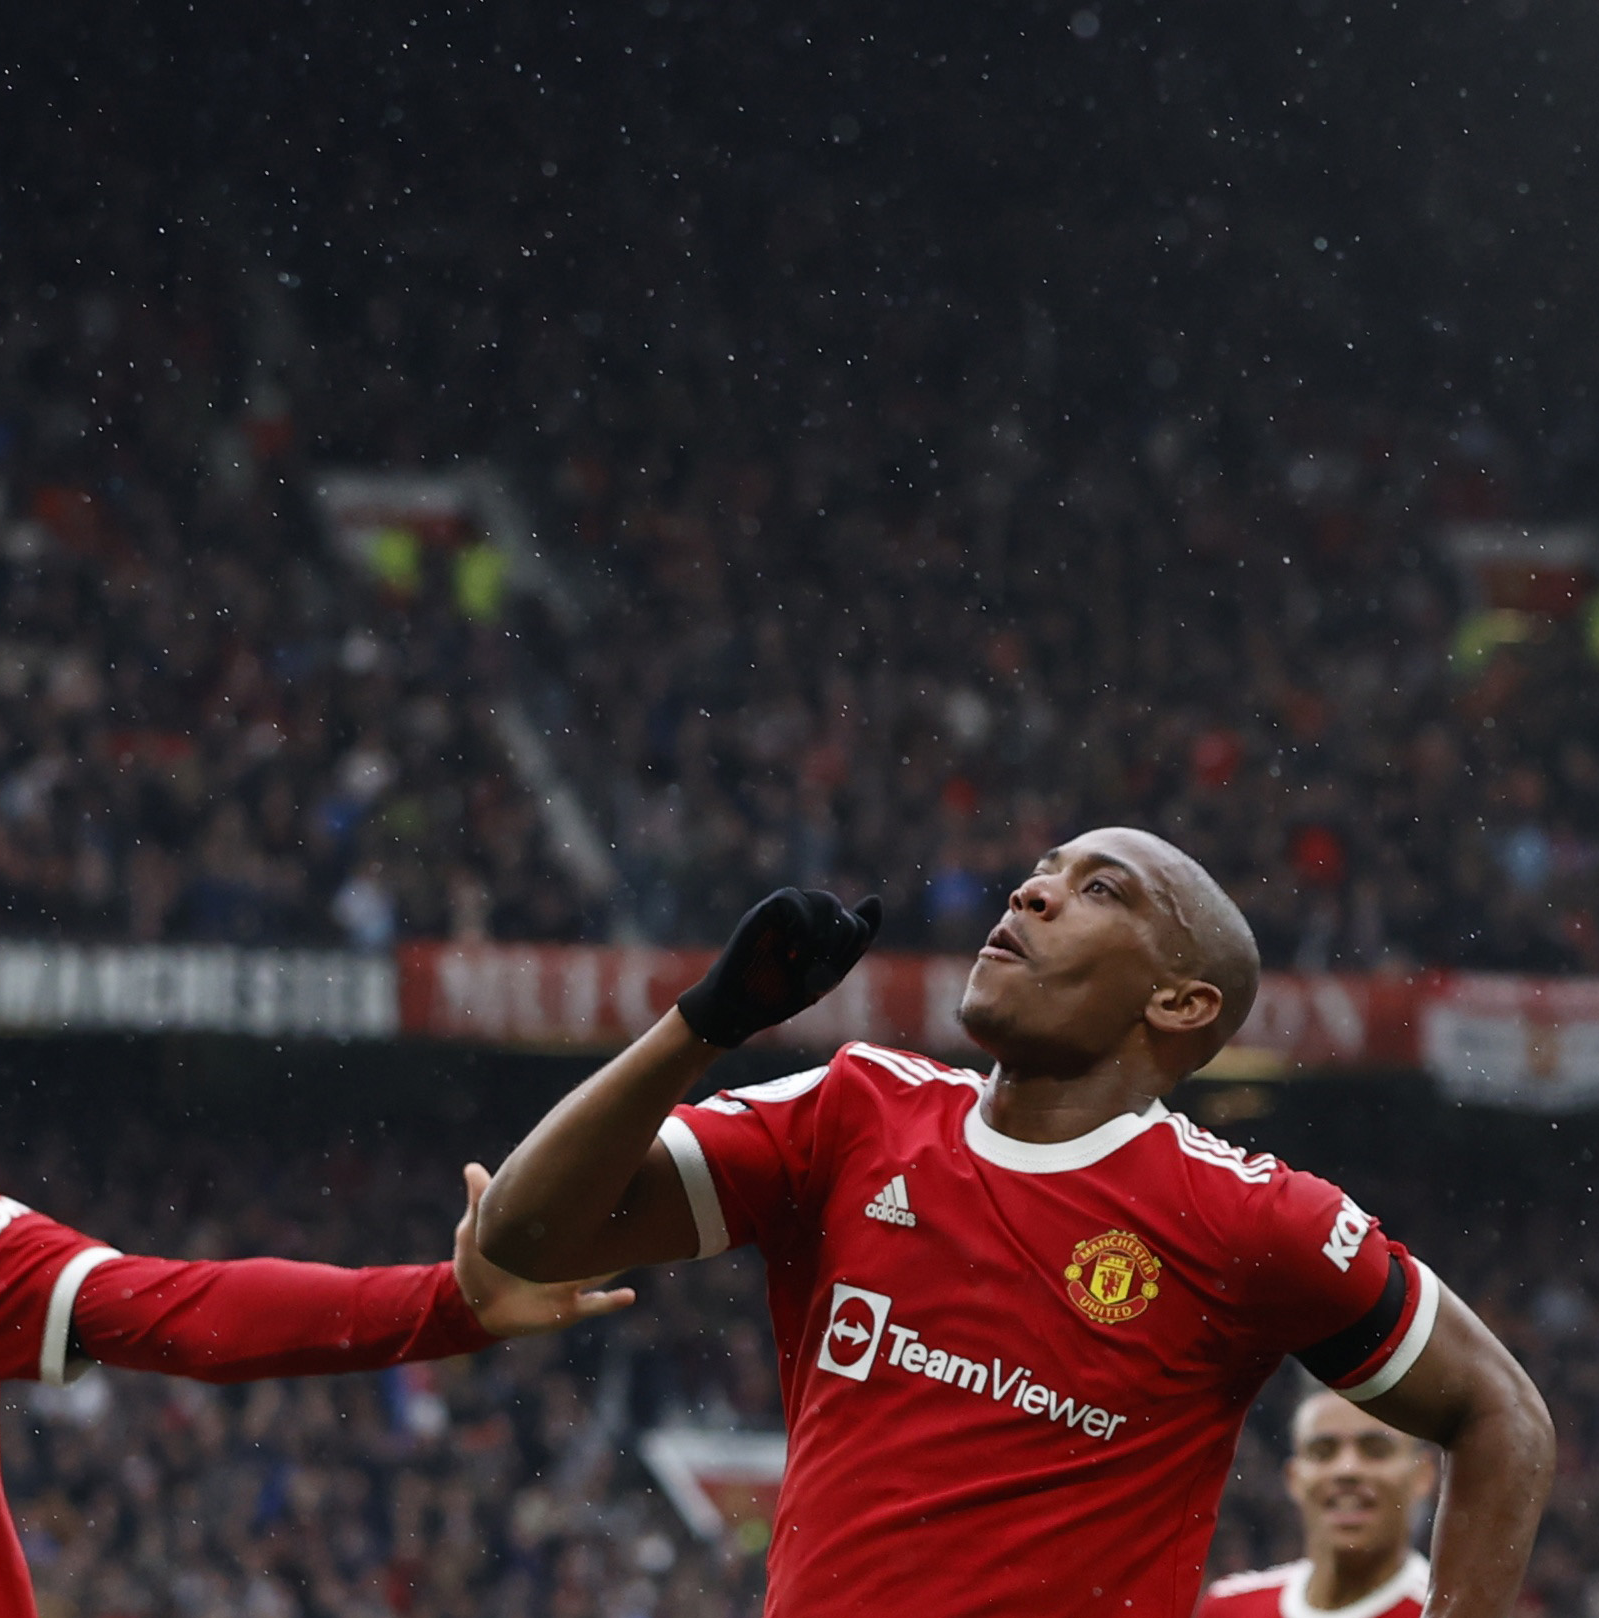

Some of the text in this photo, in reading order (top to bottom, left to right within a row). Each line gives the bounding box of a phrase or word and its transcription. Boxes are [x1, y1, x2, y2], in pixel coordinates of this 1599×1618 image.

[865, 1202, 916, 1228] adidas
[1079, 1236, 1154, 1275] MANCHESTER
[1079, 1296, 1132, 1317] UNITED
[887, 1323, 1127, 1441] TeamViewer
